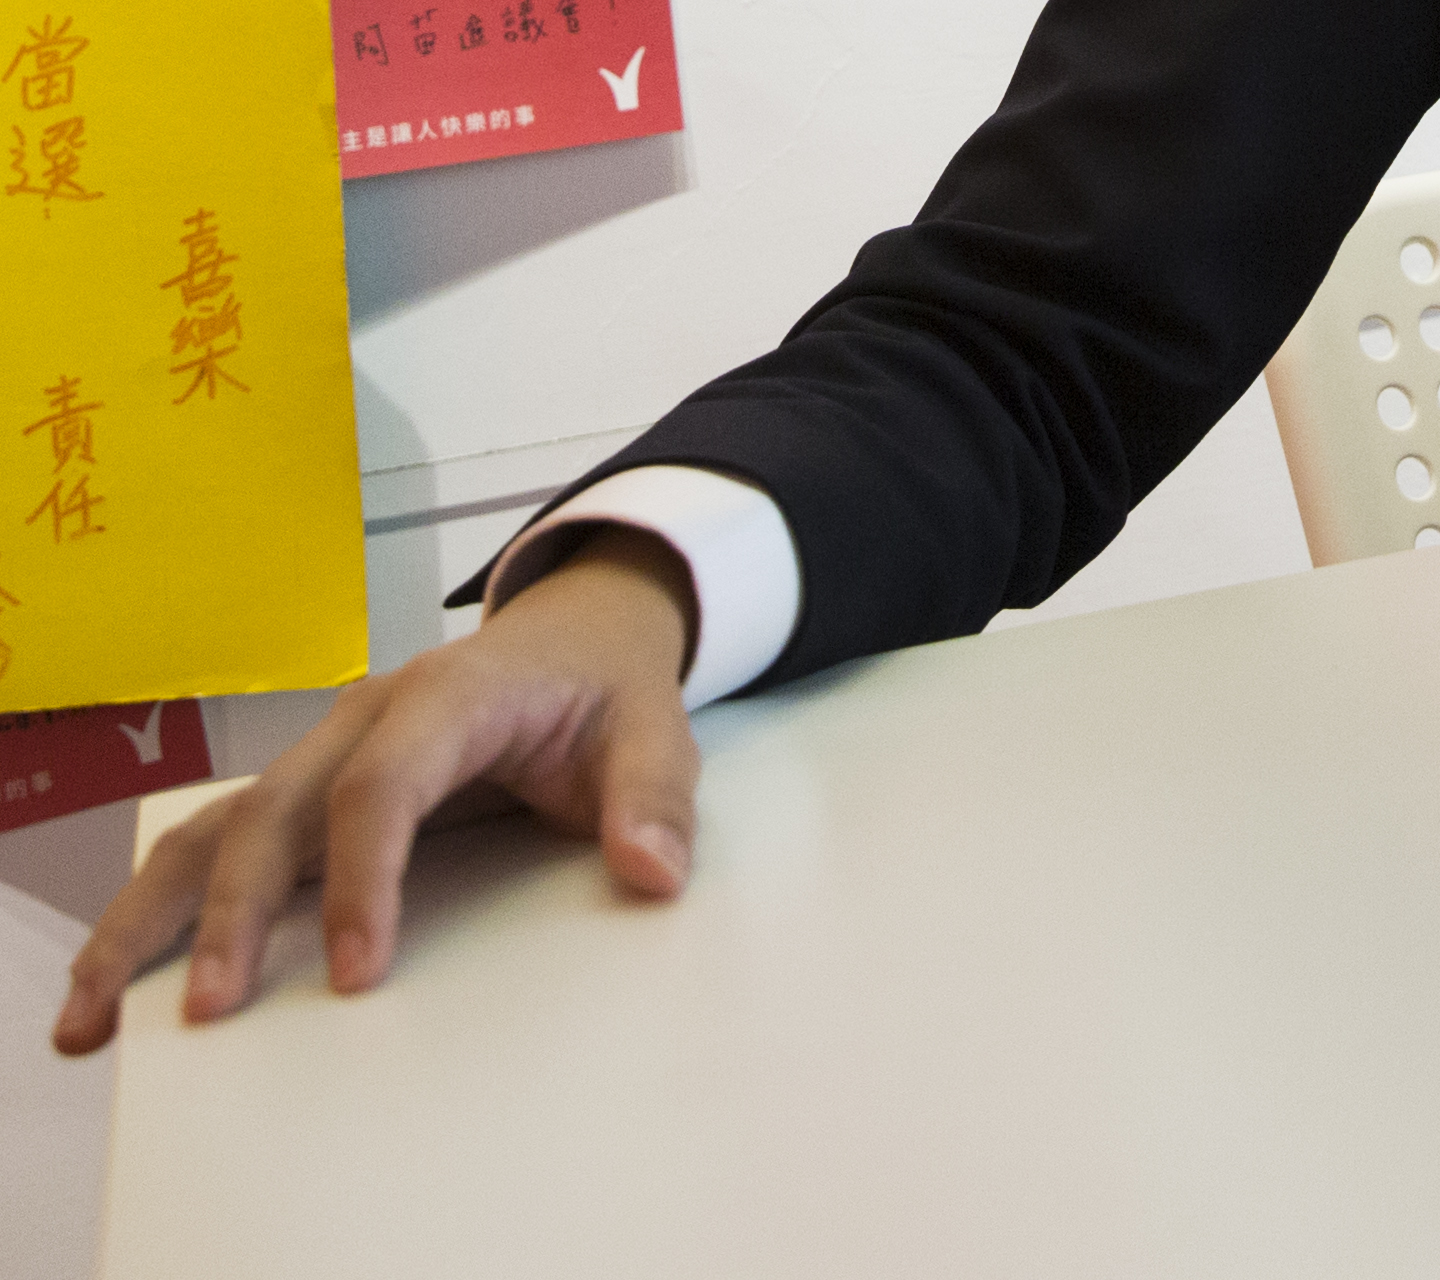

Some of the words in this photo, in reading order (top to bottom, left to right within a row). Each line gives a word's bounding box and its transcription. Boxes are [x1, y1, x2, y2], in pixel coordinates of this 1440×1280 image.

[341, 104, 537, 153] 主是讓人快樂的事
[160, 206, 252, 406] 喜樂
[22, 374, 108, 546] 責任
